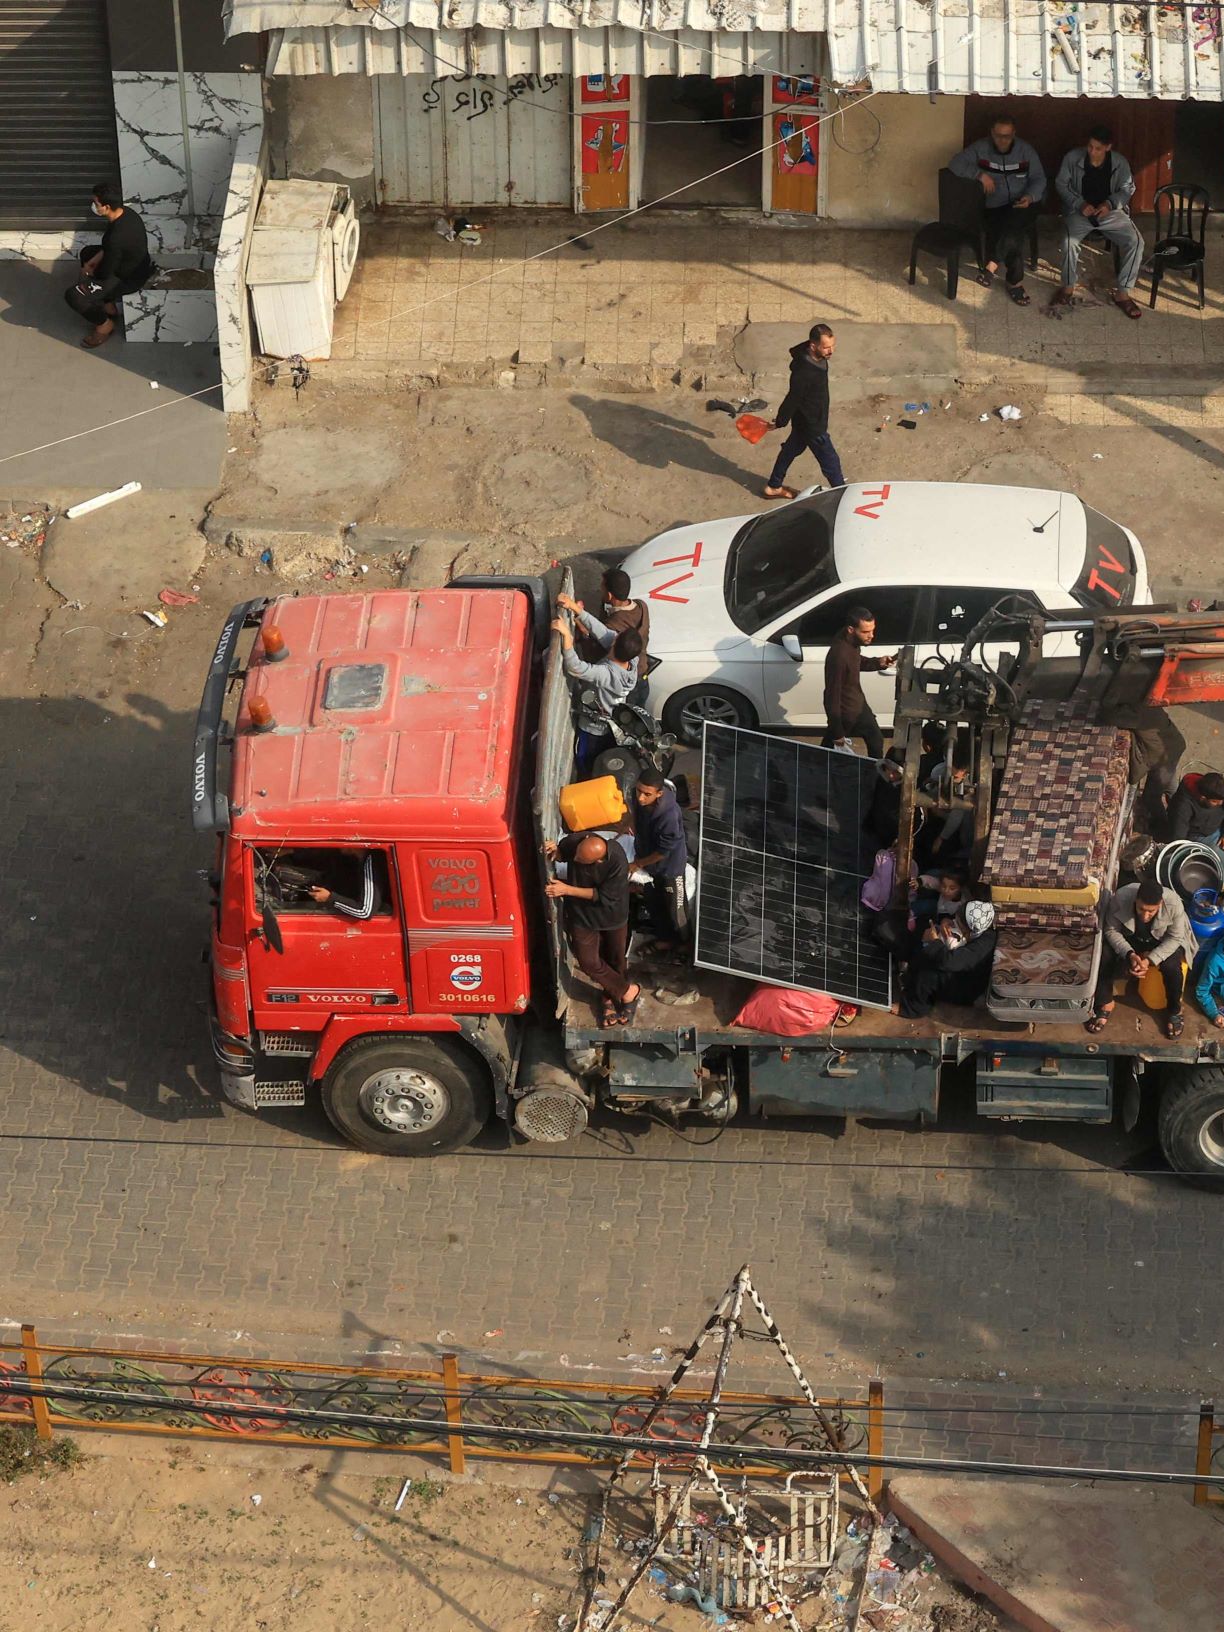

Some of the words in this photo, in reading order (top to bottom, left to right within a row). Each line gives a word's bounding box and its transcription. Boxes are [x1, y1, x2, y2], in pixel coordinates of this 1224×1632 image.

[853, 484, 891, 520] TV
[648, 541, 703, 604] TV
[1087, 544, 1126, 600] TV
[213, 621, 235, 665] VOLVO
[195, 752, 206, 802] VOLVO
[428, 858, 477, 869] VOLVO
[431, 873, 480, 896] 400
[450, 954, 482, 963] 0268
[271, 994, 297, 1004] F12
[307, 994, 367, 1004] VOLVO
[438, 993, 497, 1003] 3010616
